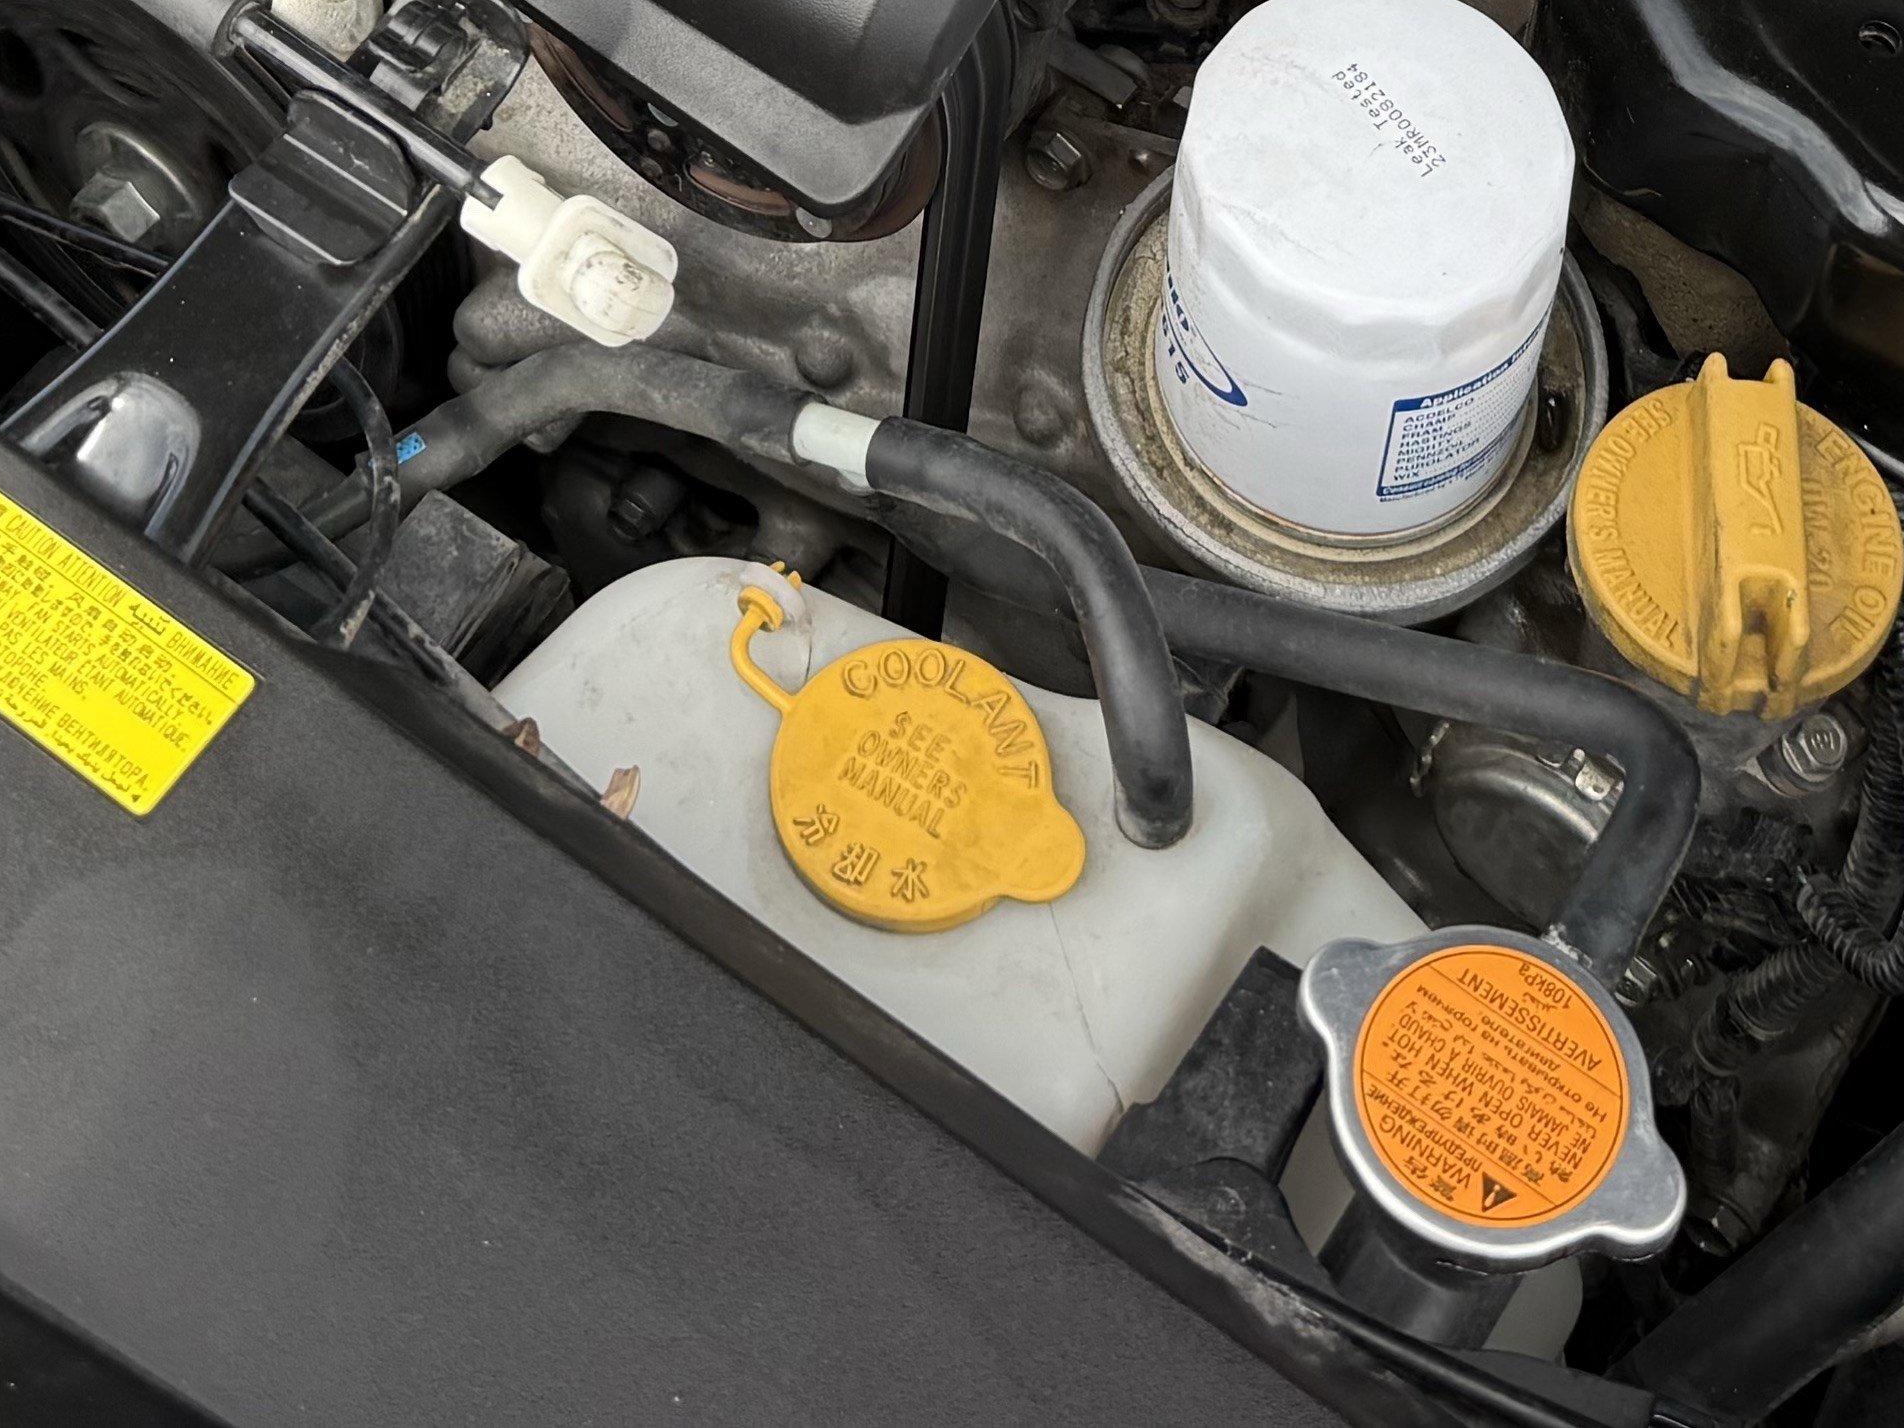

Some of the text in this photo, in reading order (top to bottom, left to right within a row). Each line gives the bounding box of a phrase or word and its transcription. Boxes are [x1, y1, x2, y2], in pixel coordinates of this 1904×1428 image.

[1331, 68, 1433, 178] Leak Tested
[1405, 397, 1473, 424] ACDELCO
[1421, 357, 1511, 409] Application
[1398, 435, 1455, 457] MIGHTY
[1400, 420, 1470, 449] HASTINGS
[1402, 425, 1442, 441] FRAM
[1404, 413, 1455, 432] CHAMP
[1626, 398, 1674, 443] SEE
[1394, 470, 1419, 482] WIX
[1395, 439, 1479, 473] PUROLATOR
[1397, 440, 1462, 465] PENNZOIL
[1586, 435, 1636, 547] OWNERS
[1816, 430, 1897, 579] ENGINE
[4, 515, 126, 608] CAUTION ATTENTION
[1592, 548, 1679, 646] MANUAL
[1830, 585, 1887, 644] OIL
[5, 606, 80, 665] VENTILATEUR
[21, 641, 48, 664] LES
[25, 601, 55, 626] FAN
[51, 620, 95, 656] STARTS
[165, 631, 238, 689] ВНИМАНИЕ
[842, 638, 1044, 790] COOLANT
[884, 709, 953, 766] SEE
[835, 753, 953, 840] MANUAL
[852, 726, 970, 813] OWNERS
[793, 803, 931, 901] 冷却水
[1517, 961, 1574, 1010] 108kPa
[1456, 965, 1602, 1073] AVERTISSEMENT
[1384, 1023, 1583, 1169] NEVER OPEN WHEN HOT.
[1458, 1058, 1591, 1153] NE JAMAIS OUVRIR
[1583, 1099, 1608, 1122] Не
[1364, 1083, 1483, 1172] ПРЕДУПРЕЖДЕНИЕ
[1376, 1113, 1474, 1188] WARNING
[1398, 1151, 1460, 1202] 警告
